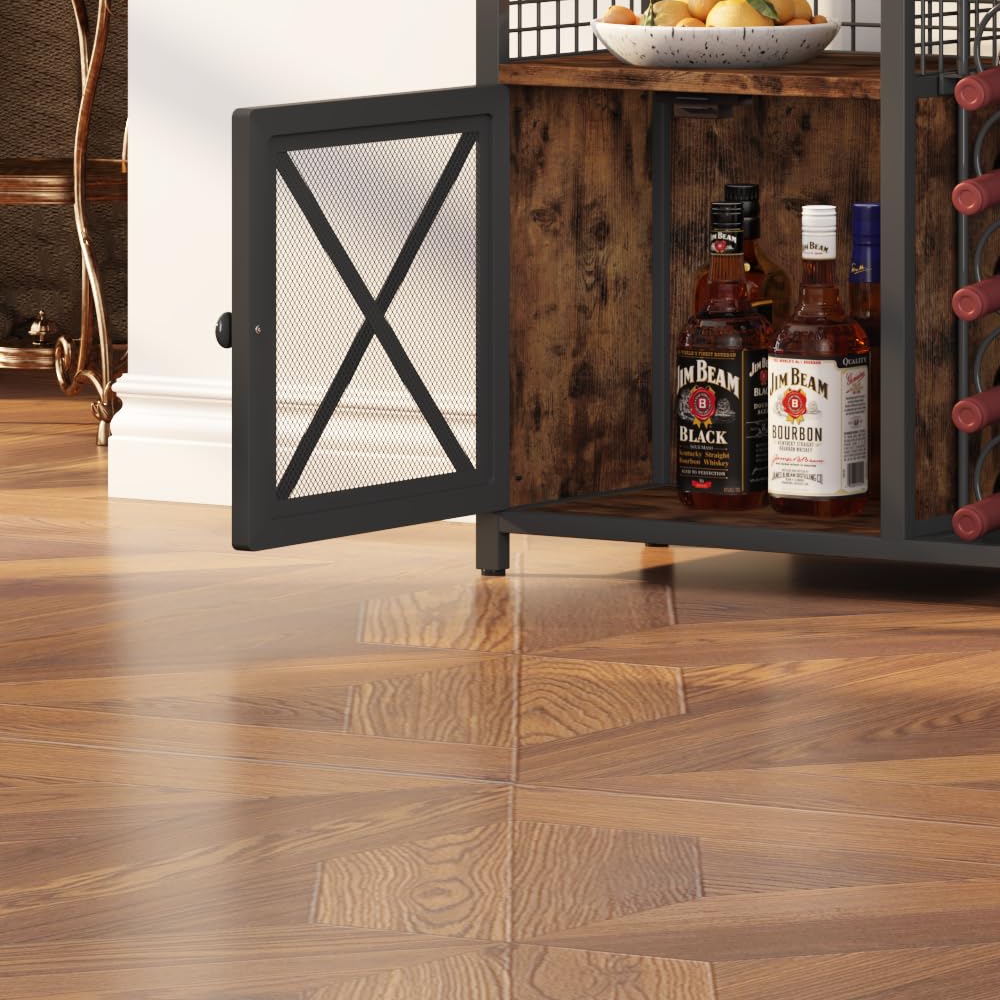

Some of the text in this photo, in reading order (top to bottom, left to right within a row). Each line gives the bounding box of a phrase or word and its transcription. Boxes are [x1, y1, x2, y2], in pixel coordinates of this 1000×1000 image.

[677, 359, 740, 399] JIM BEAM
[769, 367, 829, 400] JIM BEAM
[699, 398, 707, 409] B
[791, 398, 799, 408] B
[679, 425, 729, 445] BLACK
[772, 424, 823, 442] BOURBON
[704, 451, 730, 459] Straight
[703, 459, 729, 468] Whiskey
